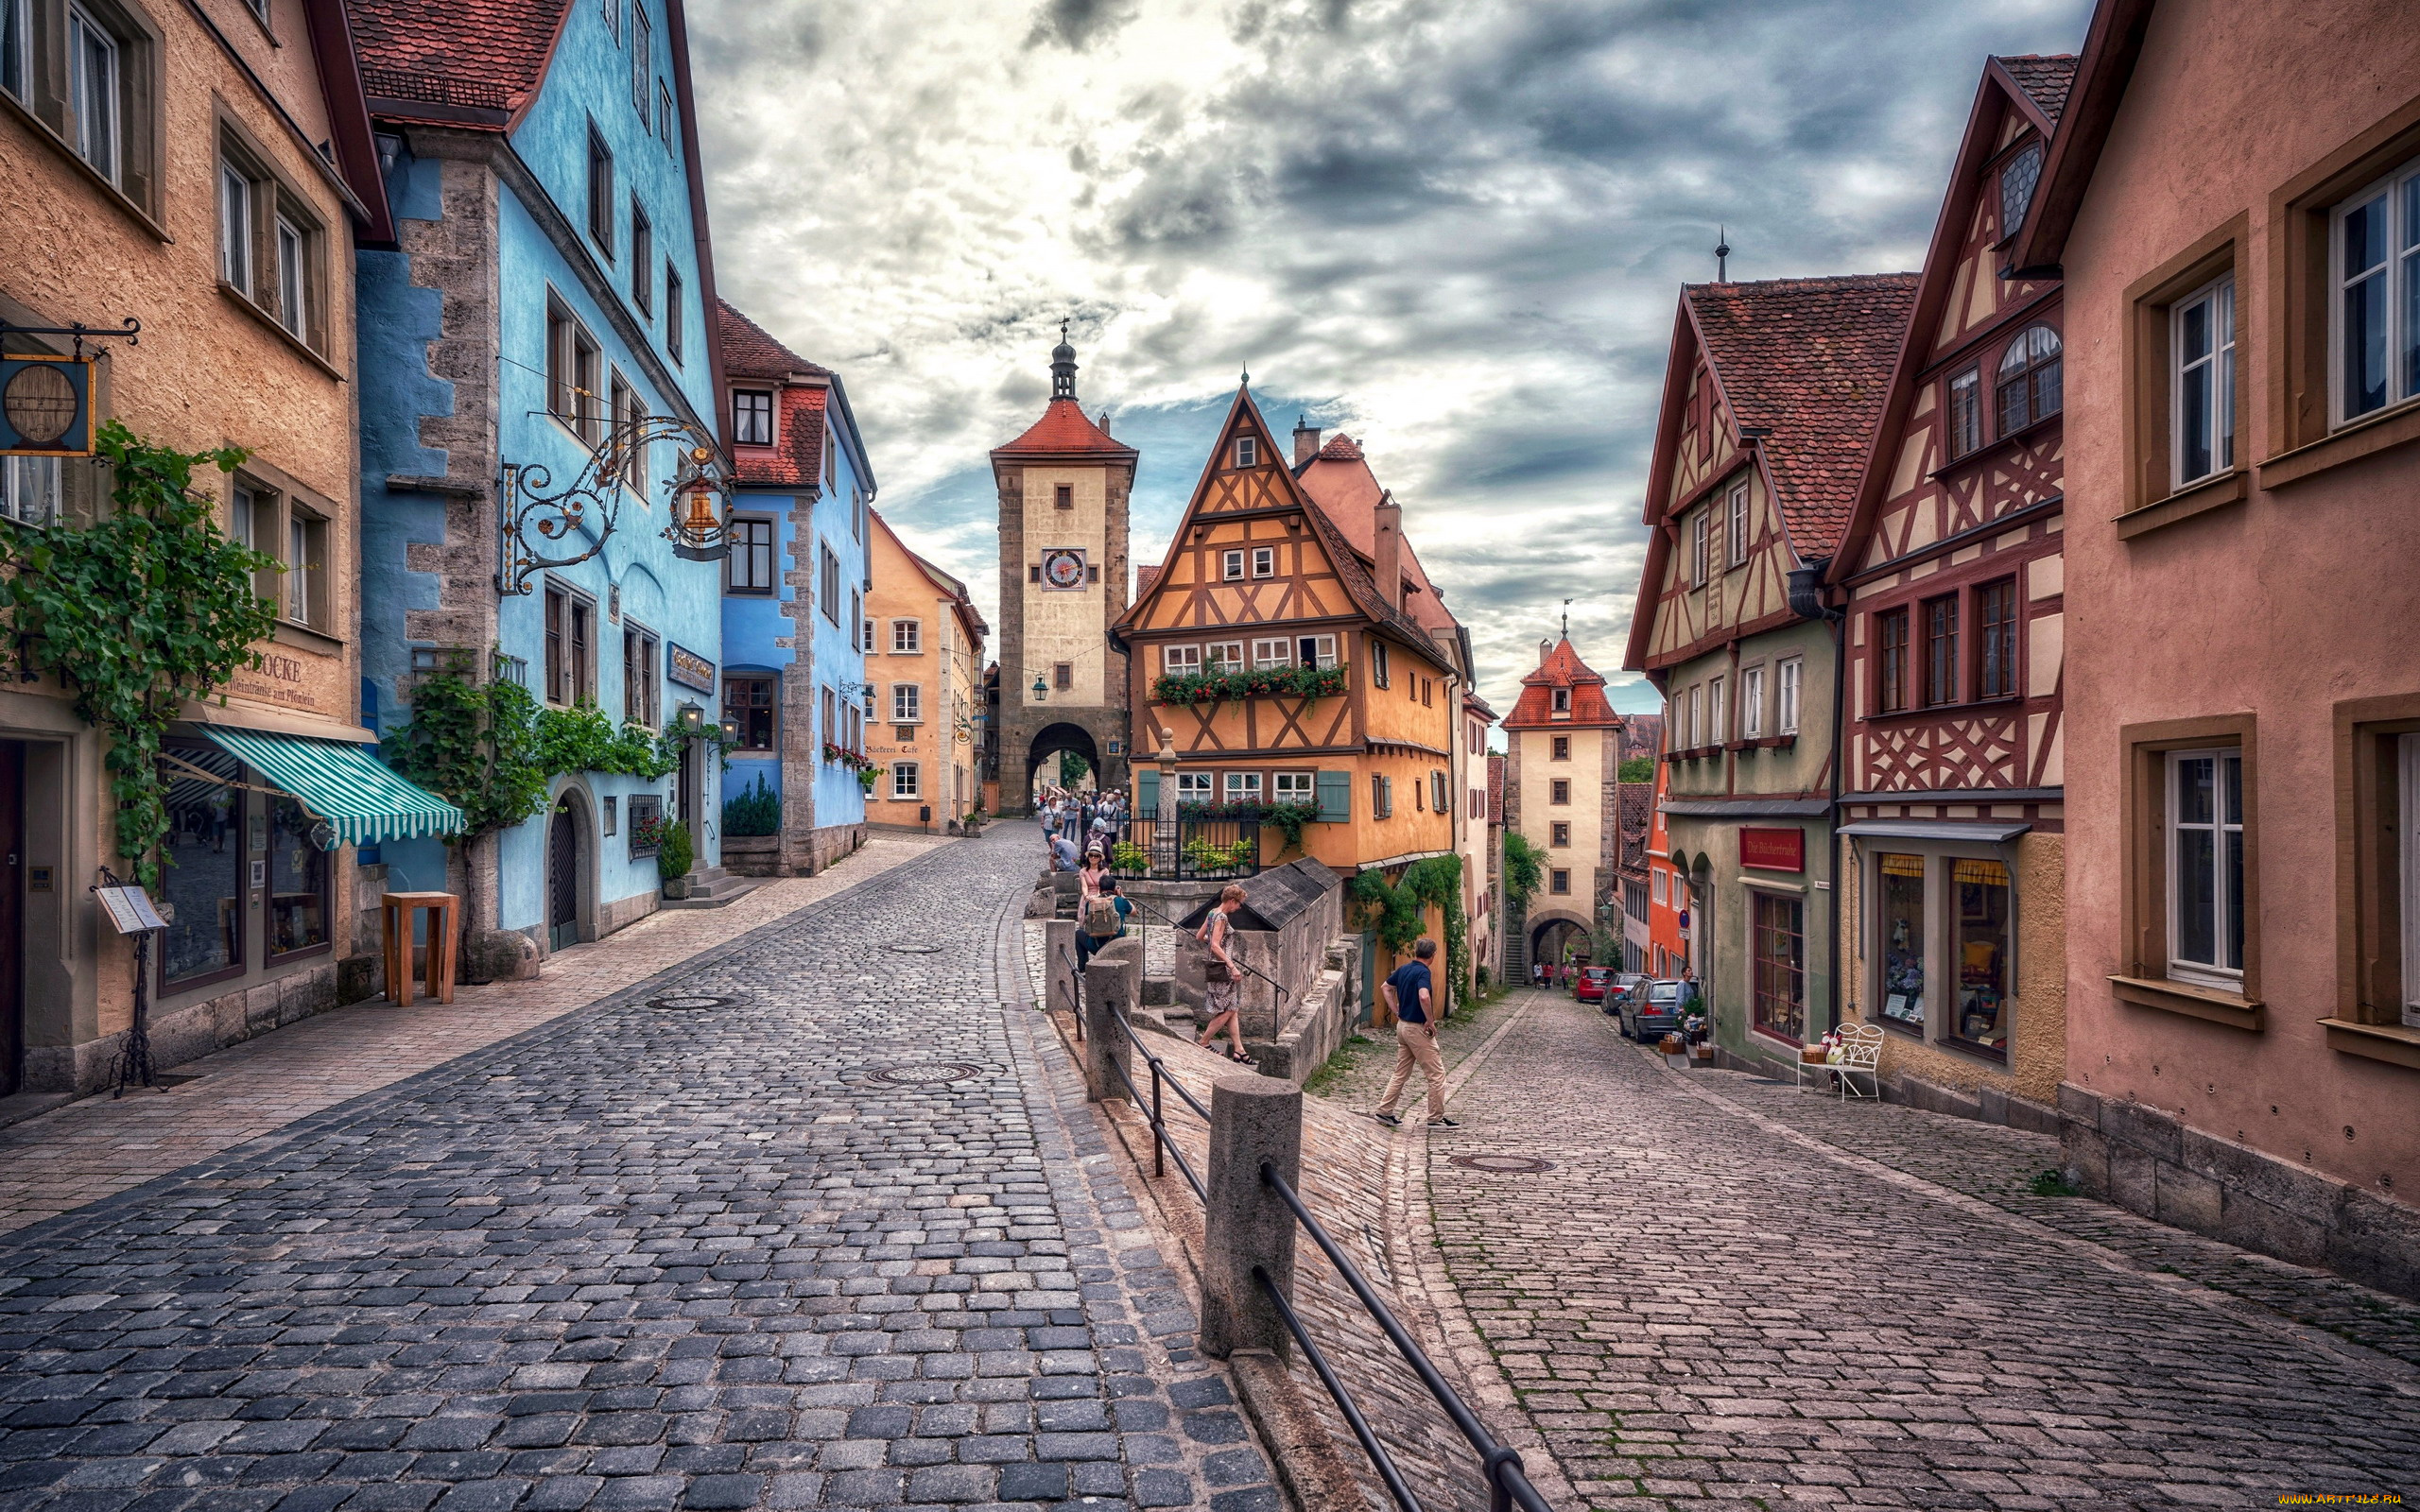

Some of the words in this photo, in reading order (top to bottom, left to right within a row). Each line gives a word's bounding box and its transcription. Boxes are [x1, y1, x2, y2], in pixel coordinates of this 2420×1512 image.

[242, 647, 301, 682] GOCKE
[274, 690, 285, 700] am
[1747, 841, 1757, 853] Die
[1759, 840, 1796, 856] Büchertruhe
